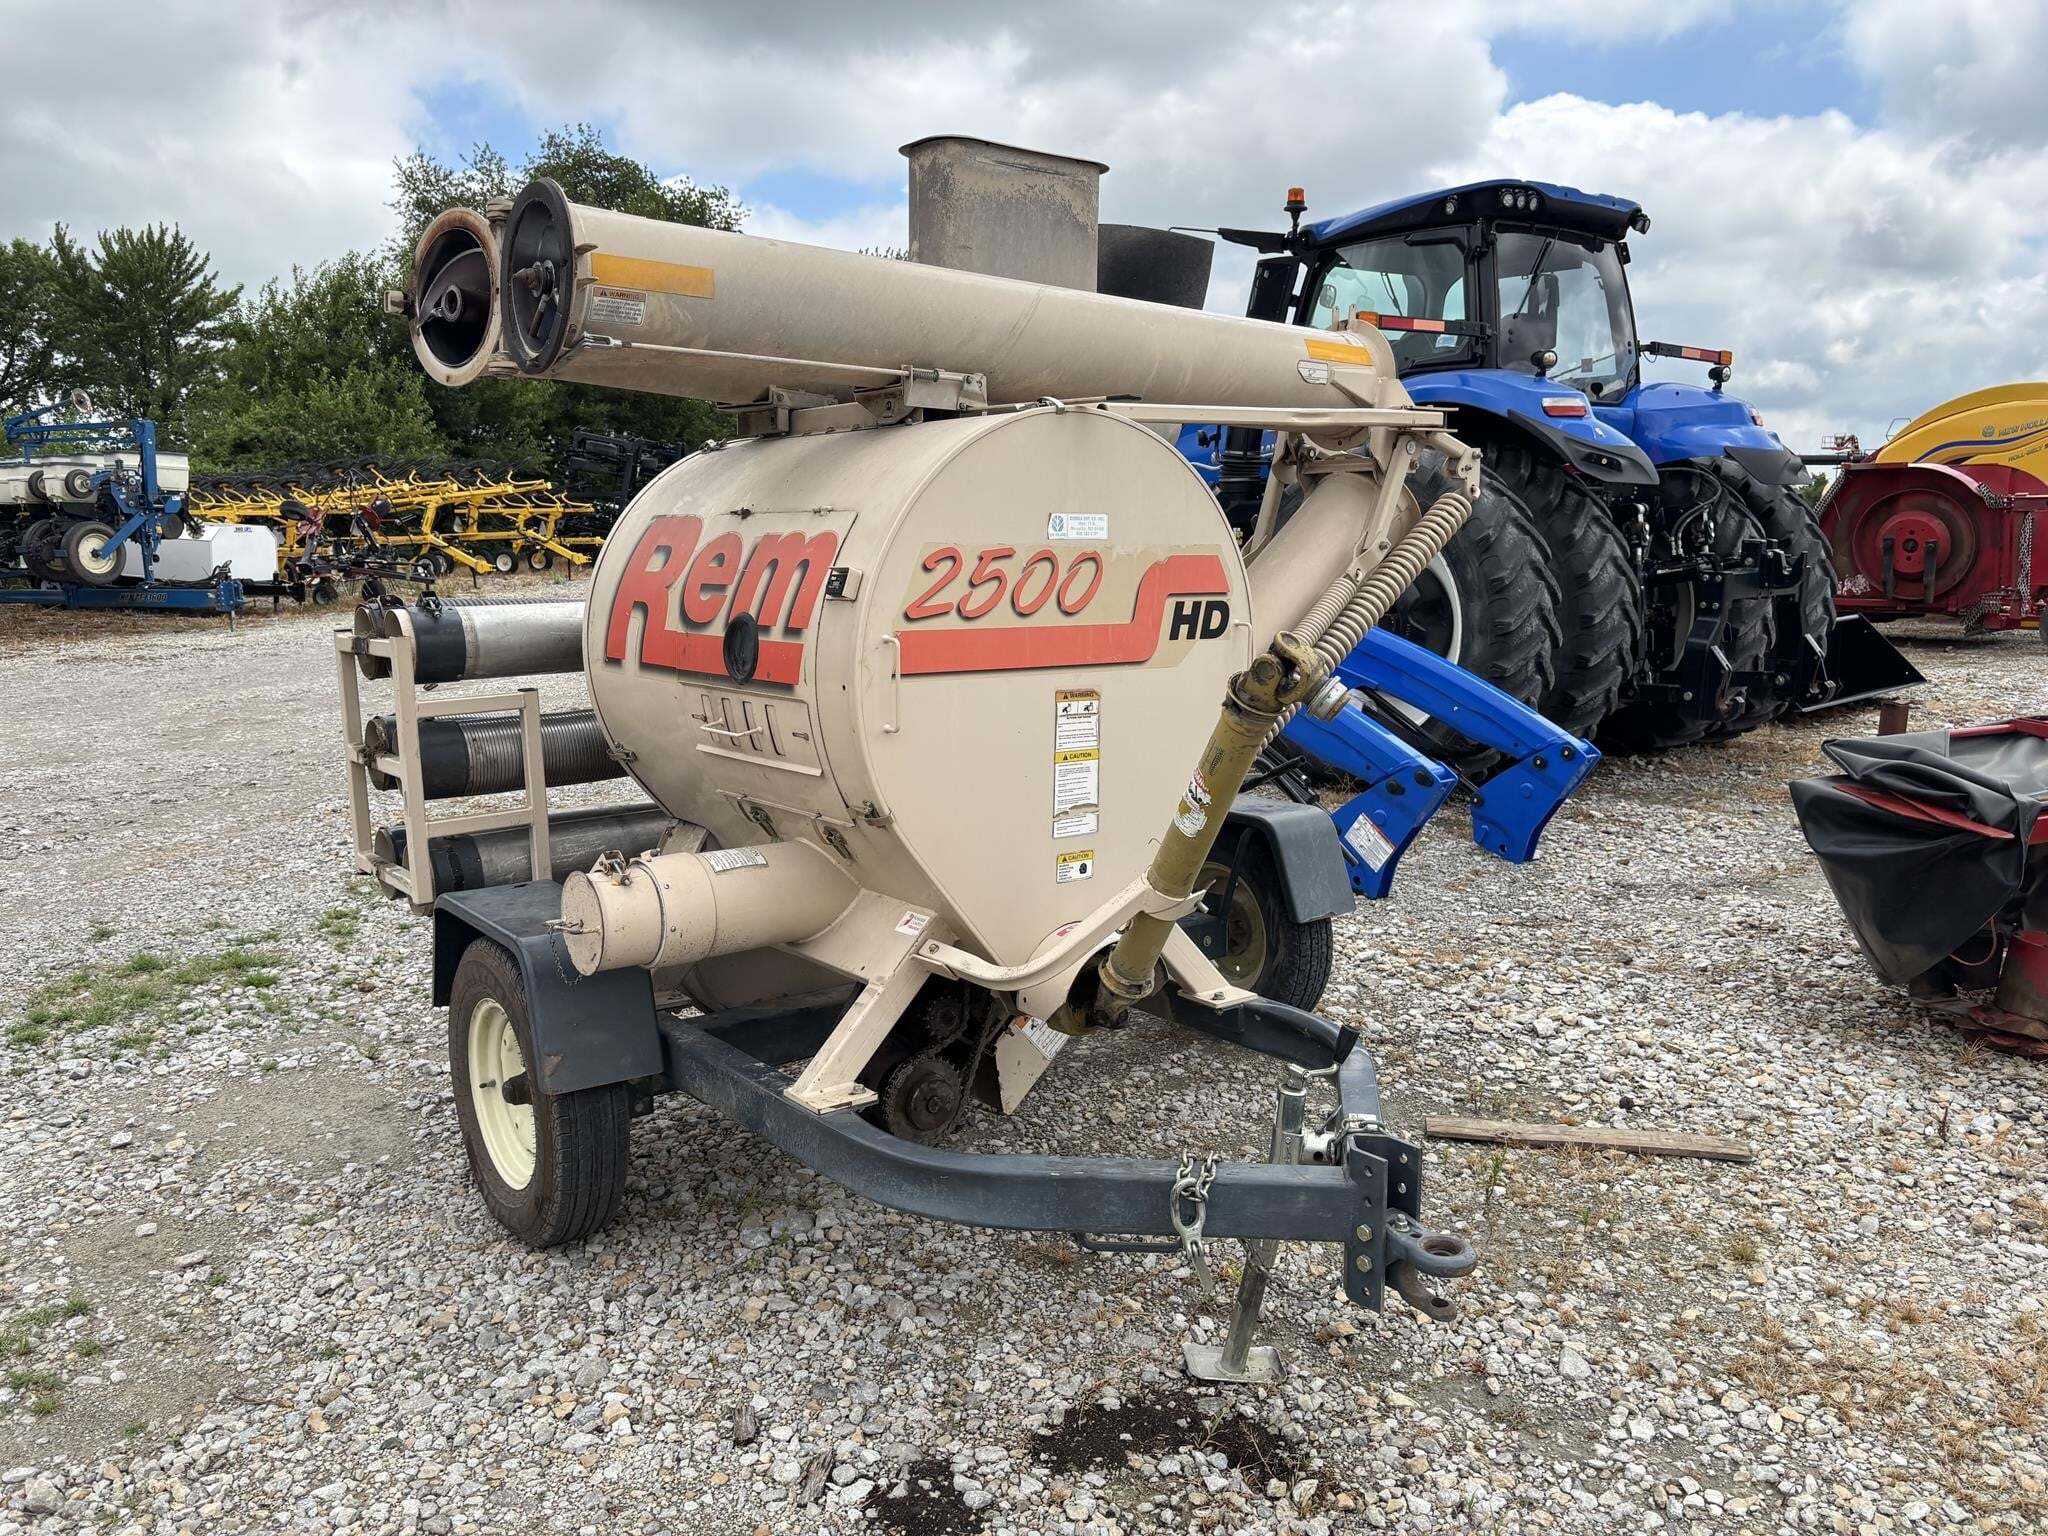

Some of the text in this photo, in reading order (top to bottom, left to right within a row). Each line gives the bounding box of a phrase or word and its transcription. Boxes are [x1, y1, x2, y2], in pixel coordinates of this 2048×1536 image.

[609, 289, 640, 299] WARNING
[905, 546, 1103, 618] 2500
[607, 514, 838, 672] Rem
[1168, 600, 1230, 640] HD
[1070, 691, 1095, 699] WARNING
[1070, 752, 1092, 760] CAUTION
[1068, 853, 1089, 861] CAUTION
